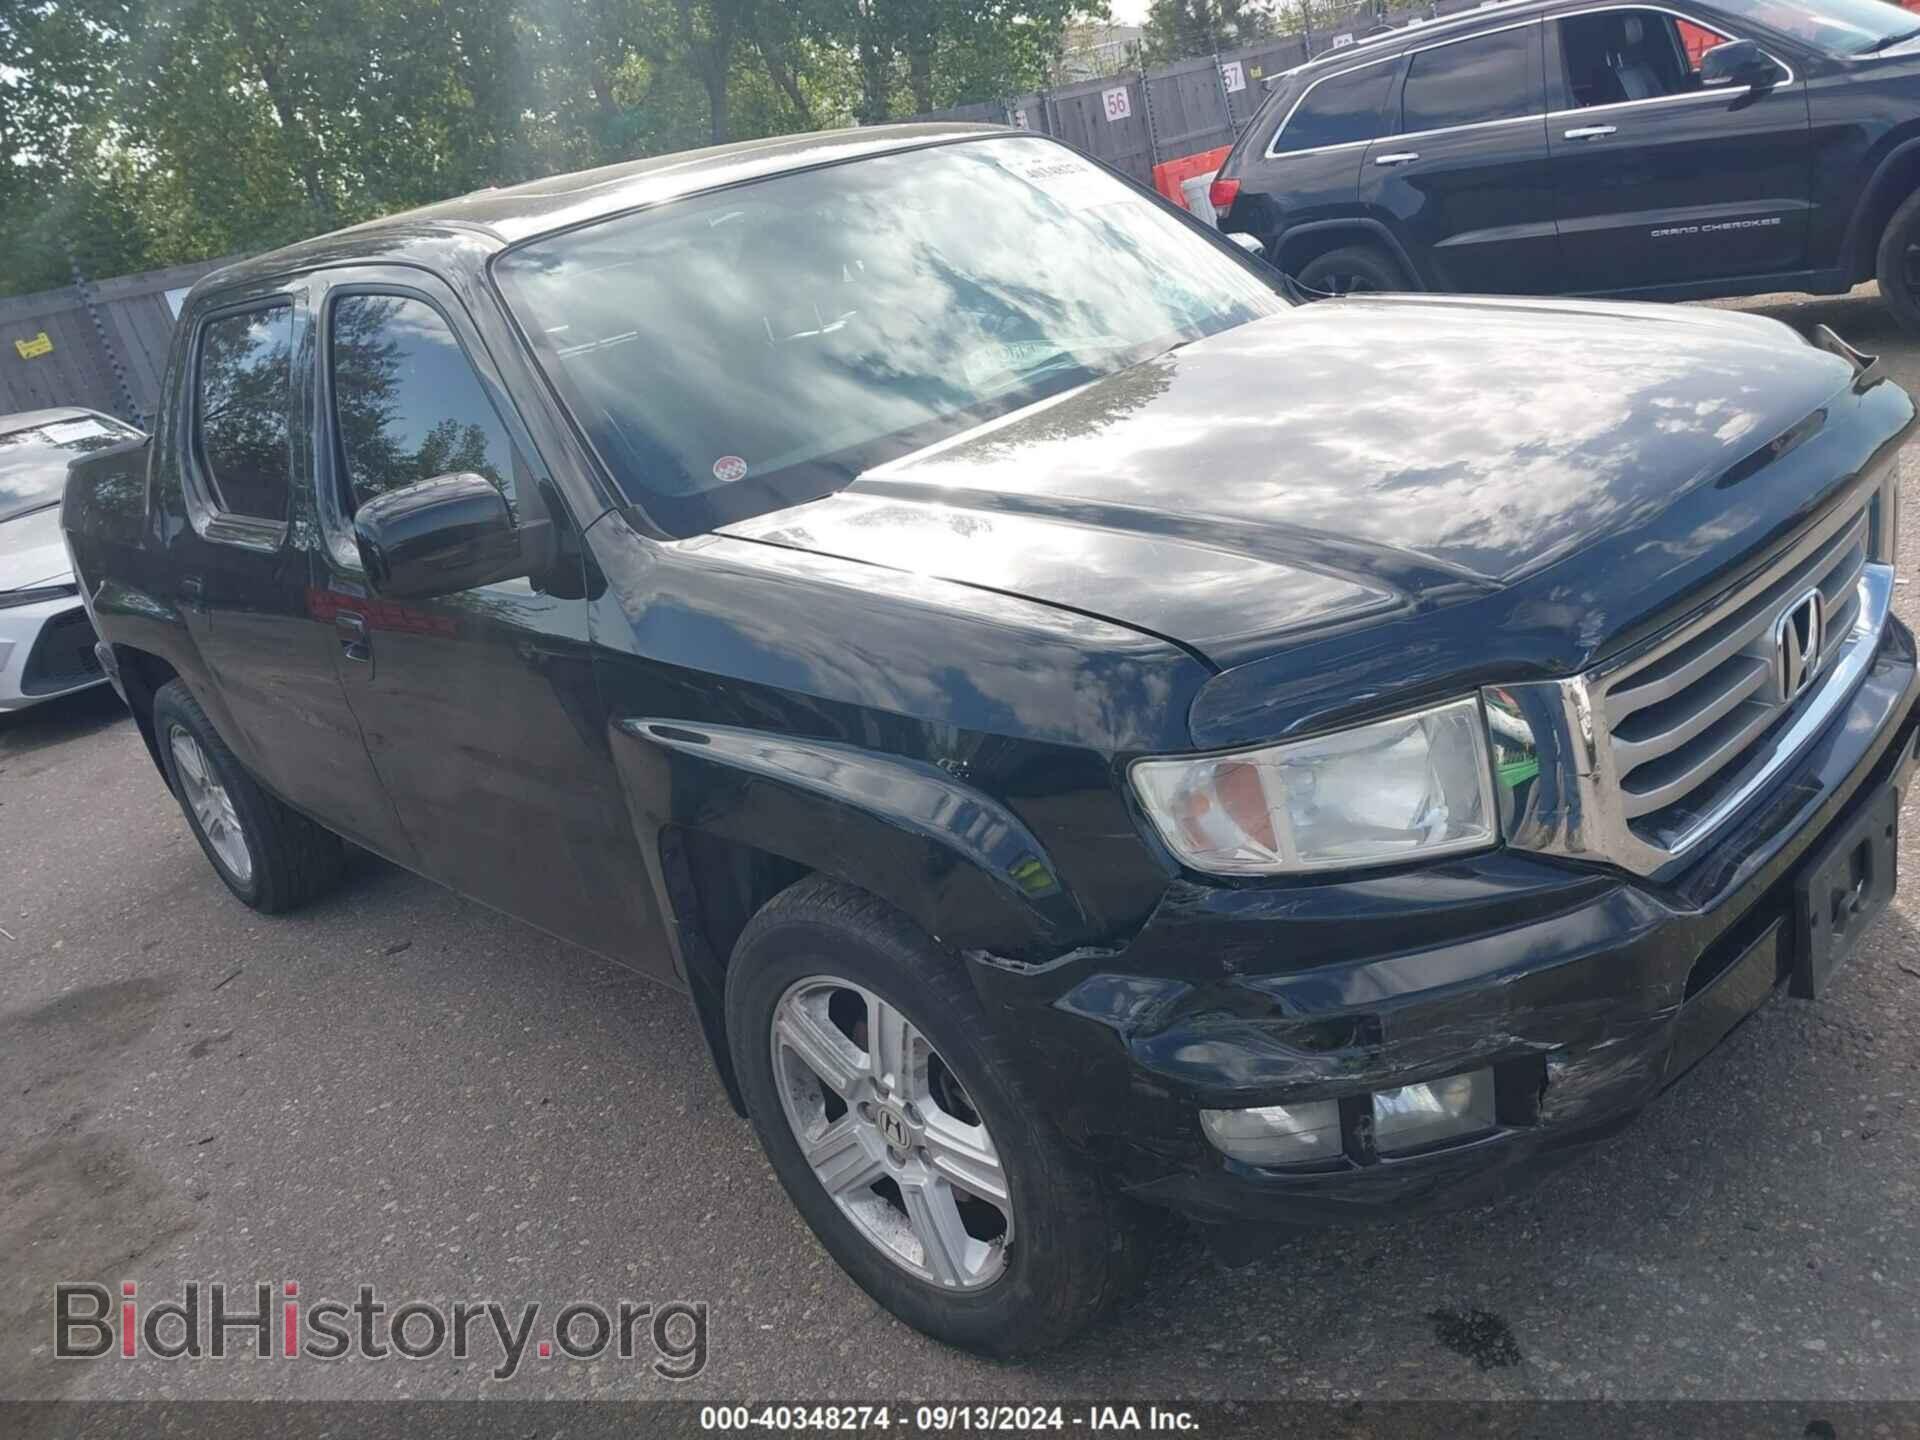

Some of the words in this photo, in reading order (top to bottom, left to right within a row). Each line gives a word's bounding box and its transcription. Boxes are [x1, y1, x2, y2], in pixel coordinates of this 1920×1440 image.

[1107, 92, 1126, 115] 56
[1651, 226, 1699, 237] GRAND
[1701, 217, 1781, 232] CHEROKEE
